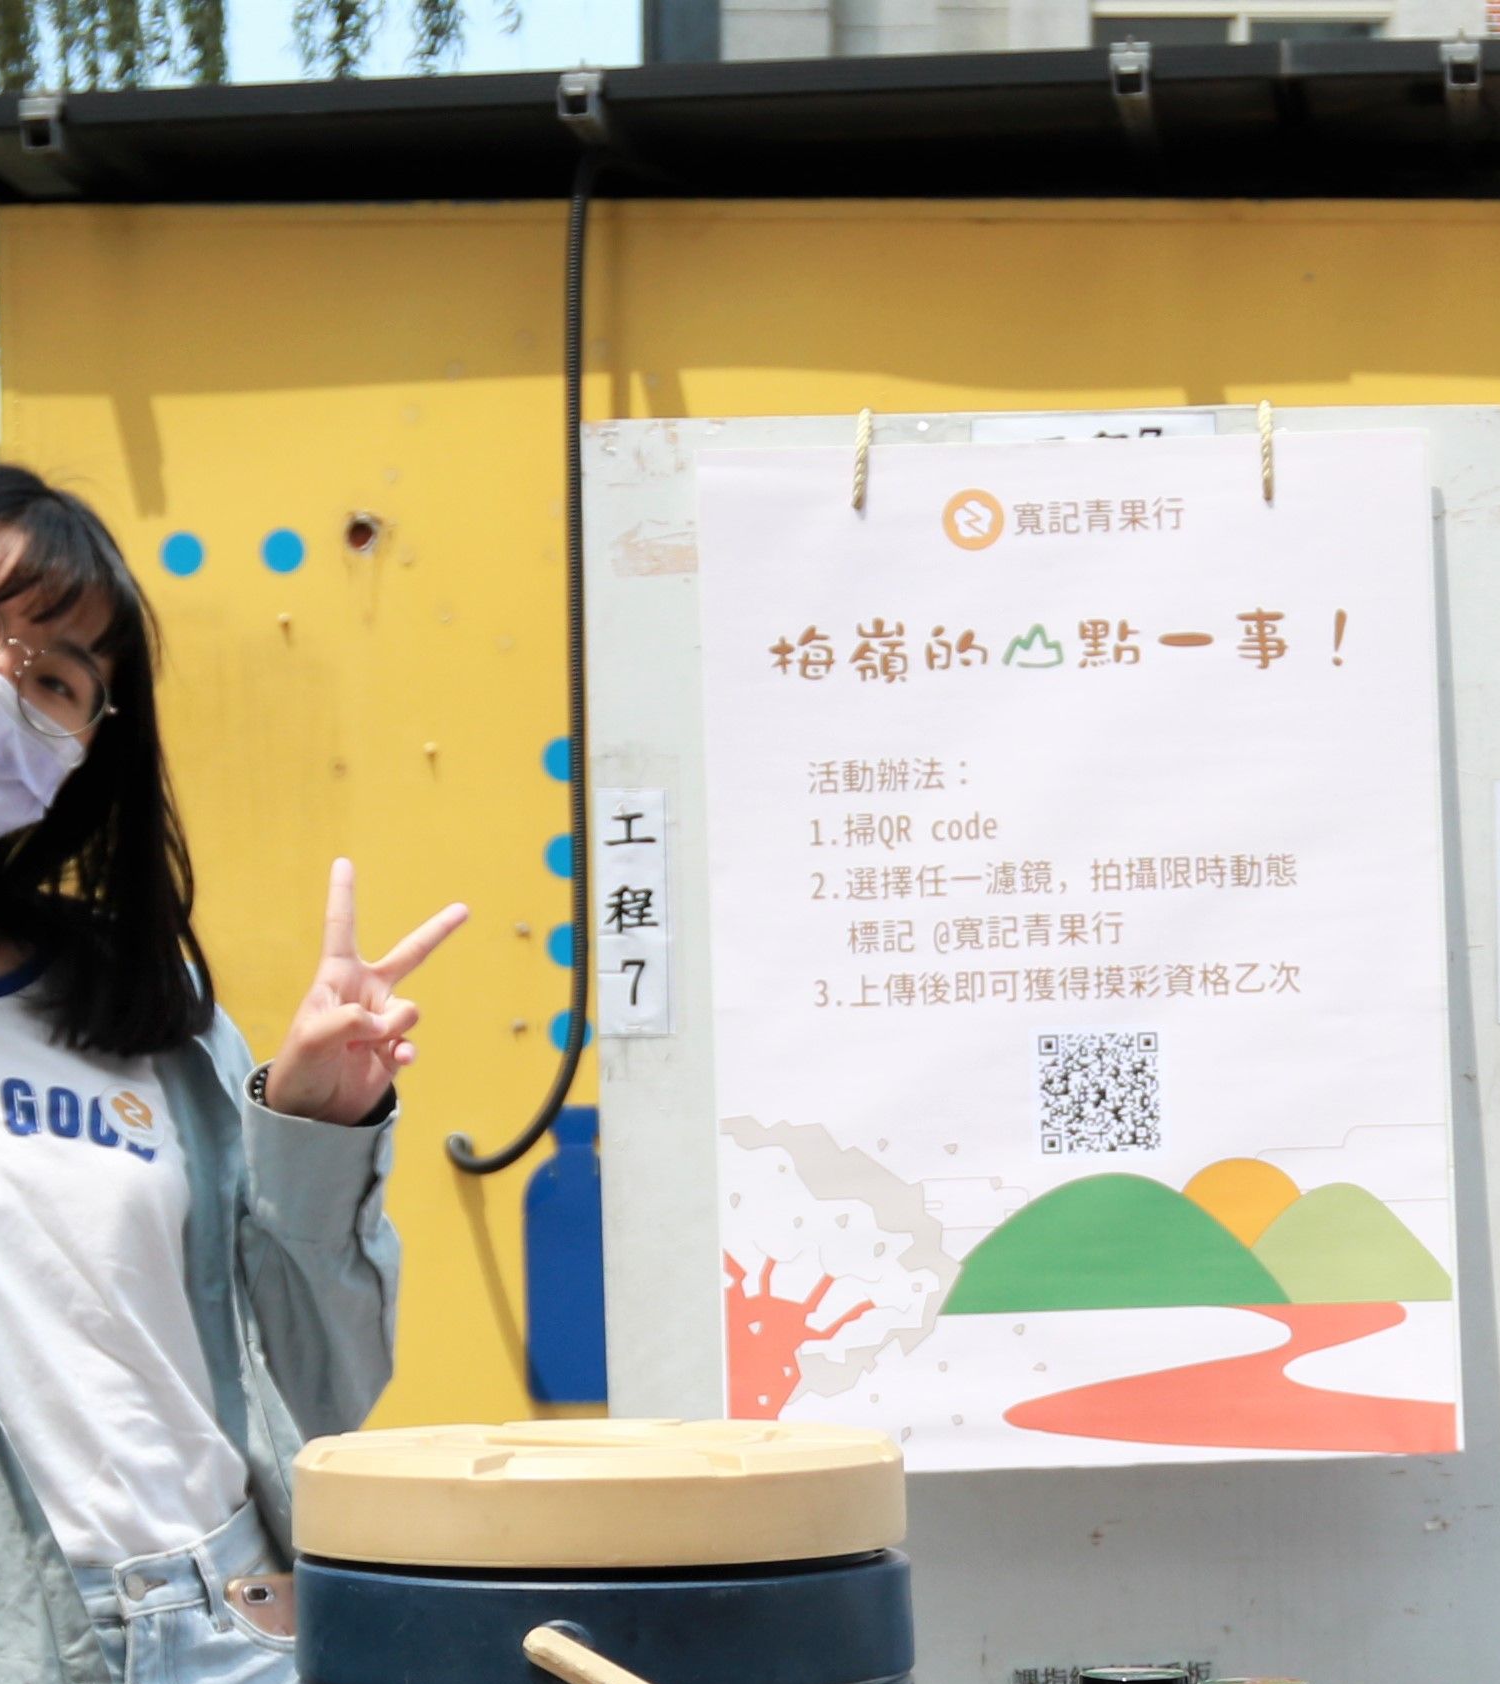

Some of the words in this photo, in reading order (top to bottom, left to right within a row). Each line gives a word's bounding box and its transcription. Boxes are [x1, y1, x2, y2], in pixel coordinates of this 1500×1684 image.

[1013, 496, 1185, 536] 寬記青果行
[930, 811, 1000, 844] code
[846, 919, 917, 955] 標記
[0, 1076, 156, 1164] GOO
